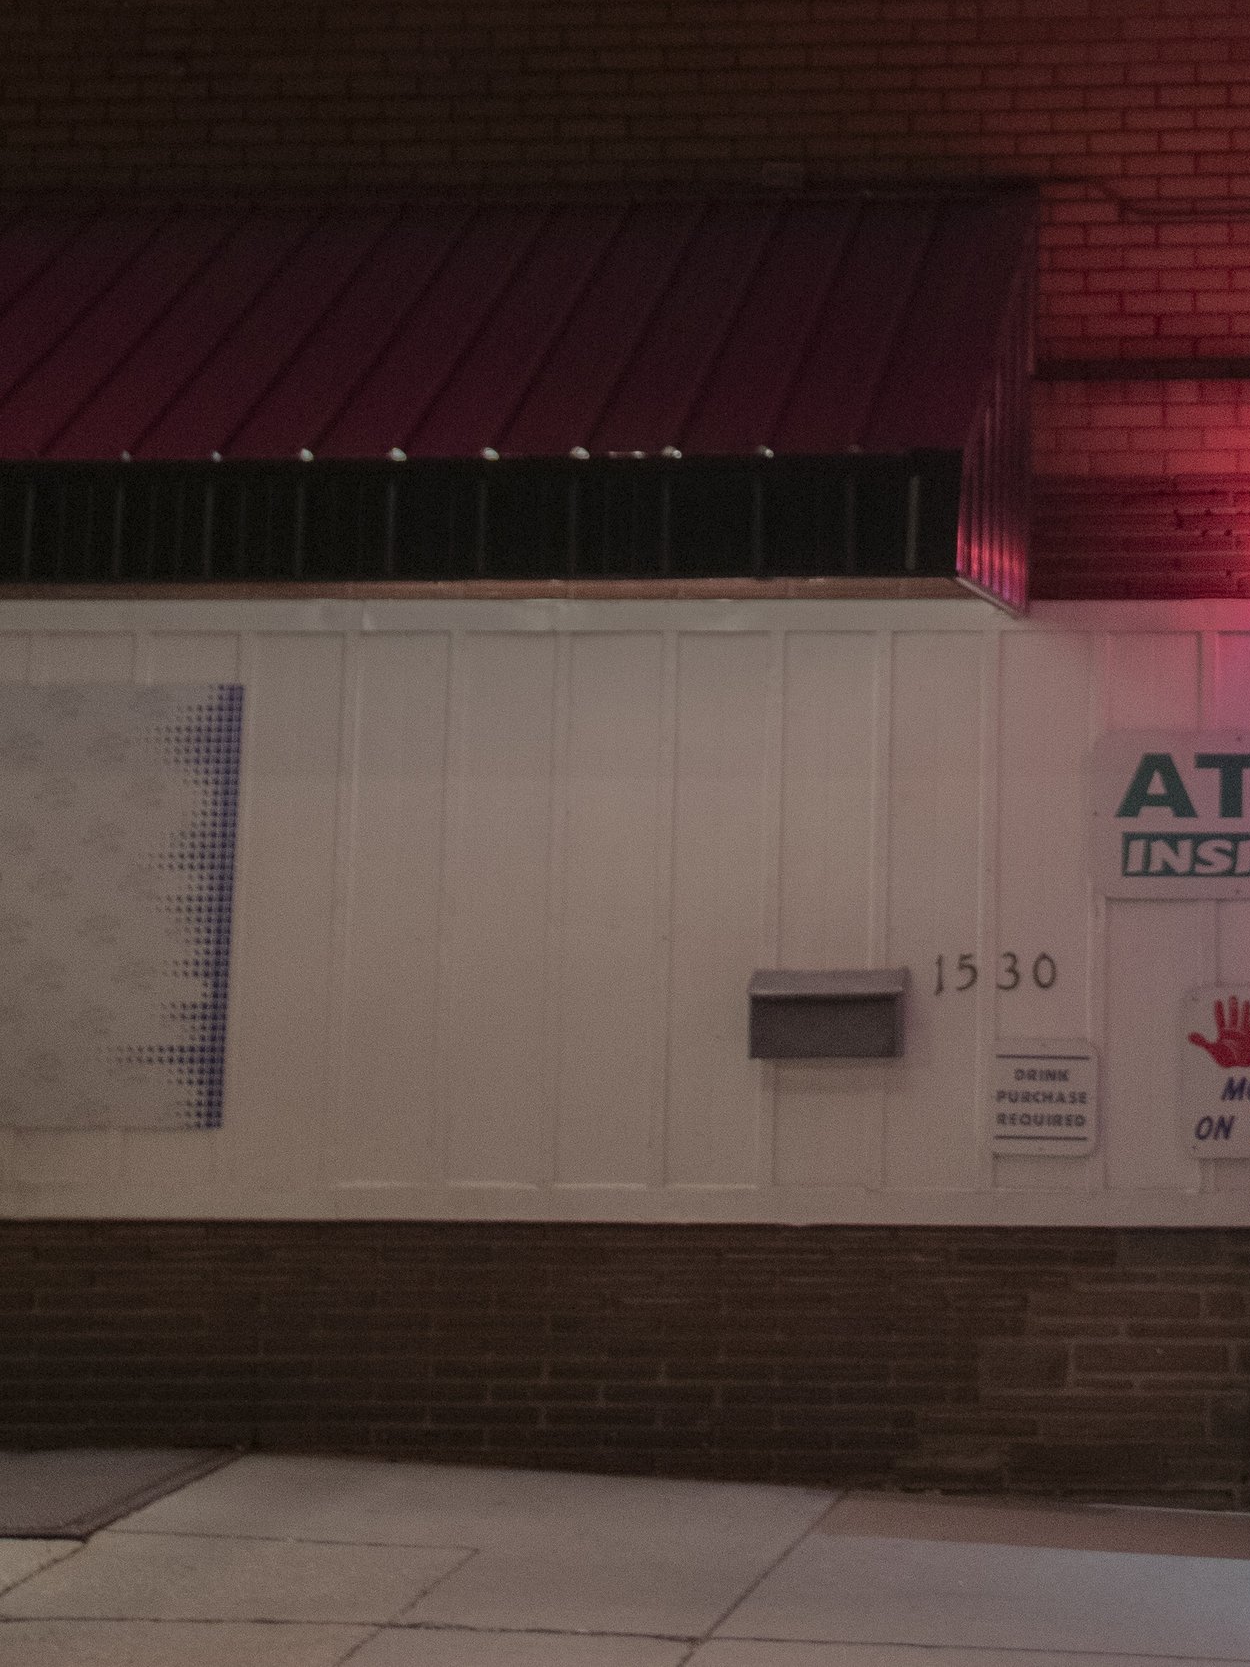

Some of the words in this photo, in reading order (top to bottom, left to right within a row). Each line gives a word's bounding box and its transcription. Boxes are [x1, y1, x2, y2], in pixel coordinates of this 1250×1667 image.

[934, 951, 1058, 997] 1530
[1013, 1068, 1069, 1083] DRINK
[996, 1091, 1087, 1105] PURCHASE
[996, 1113, 1086, 1128] REQUIRED
[1194, 1114, 1233, 1141] ON
